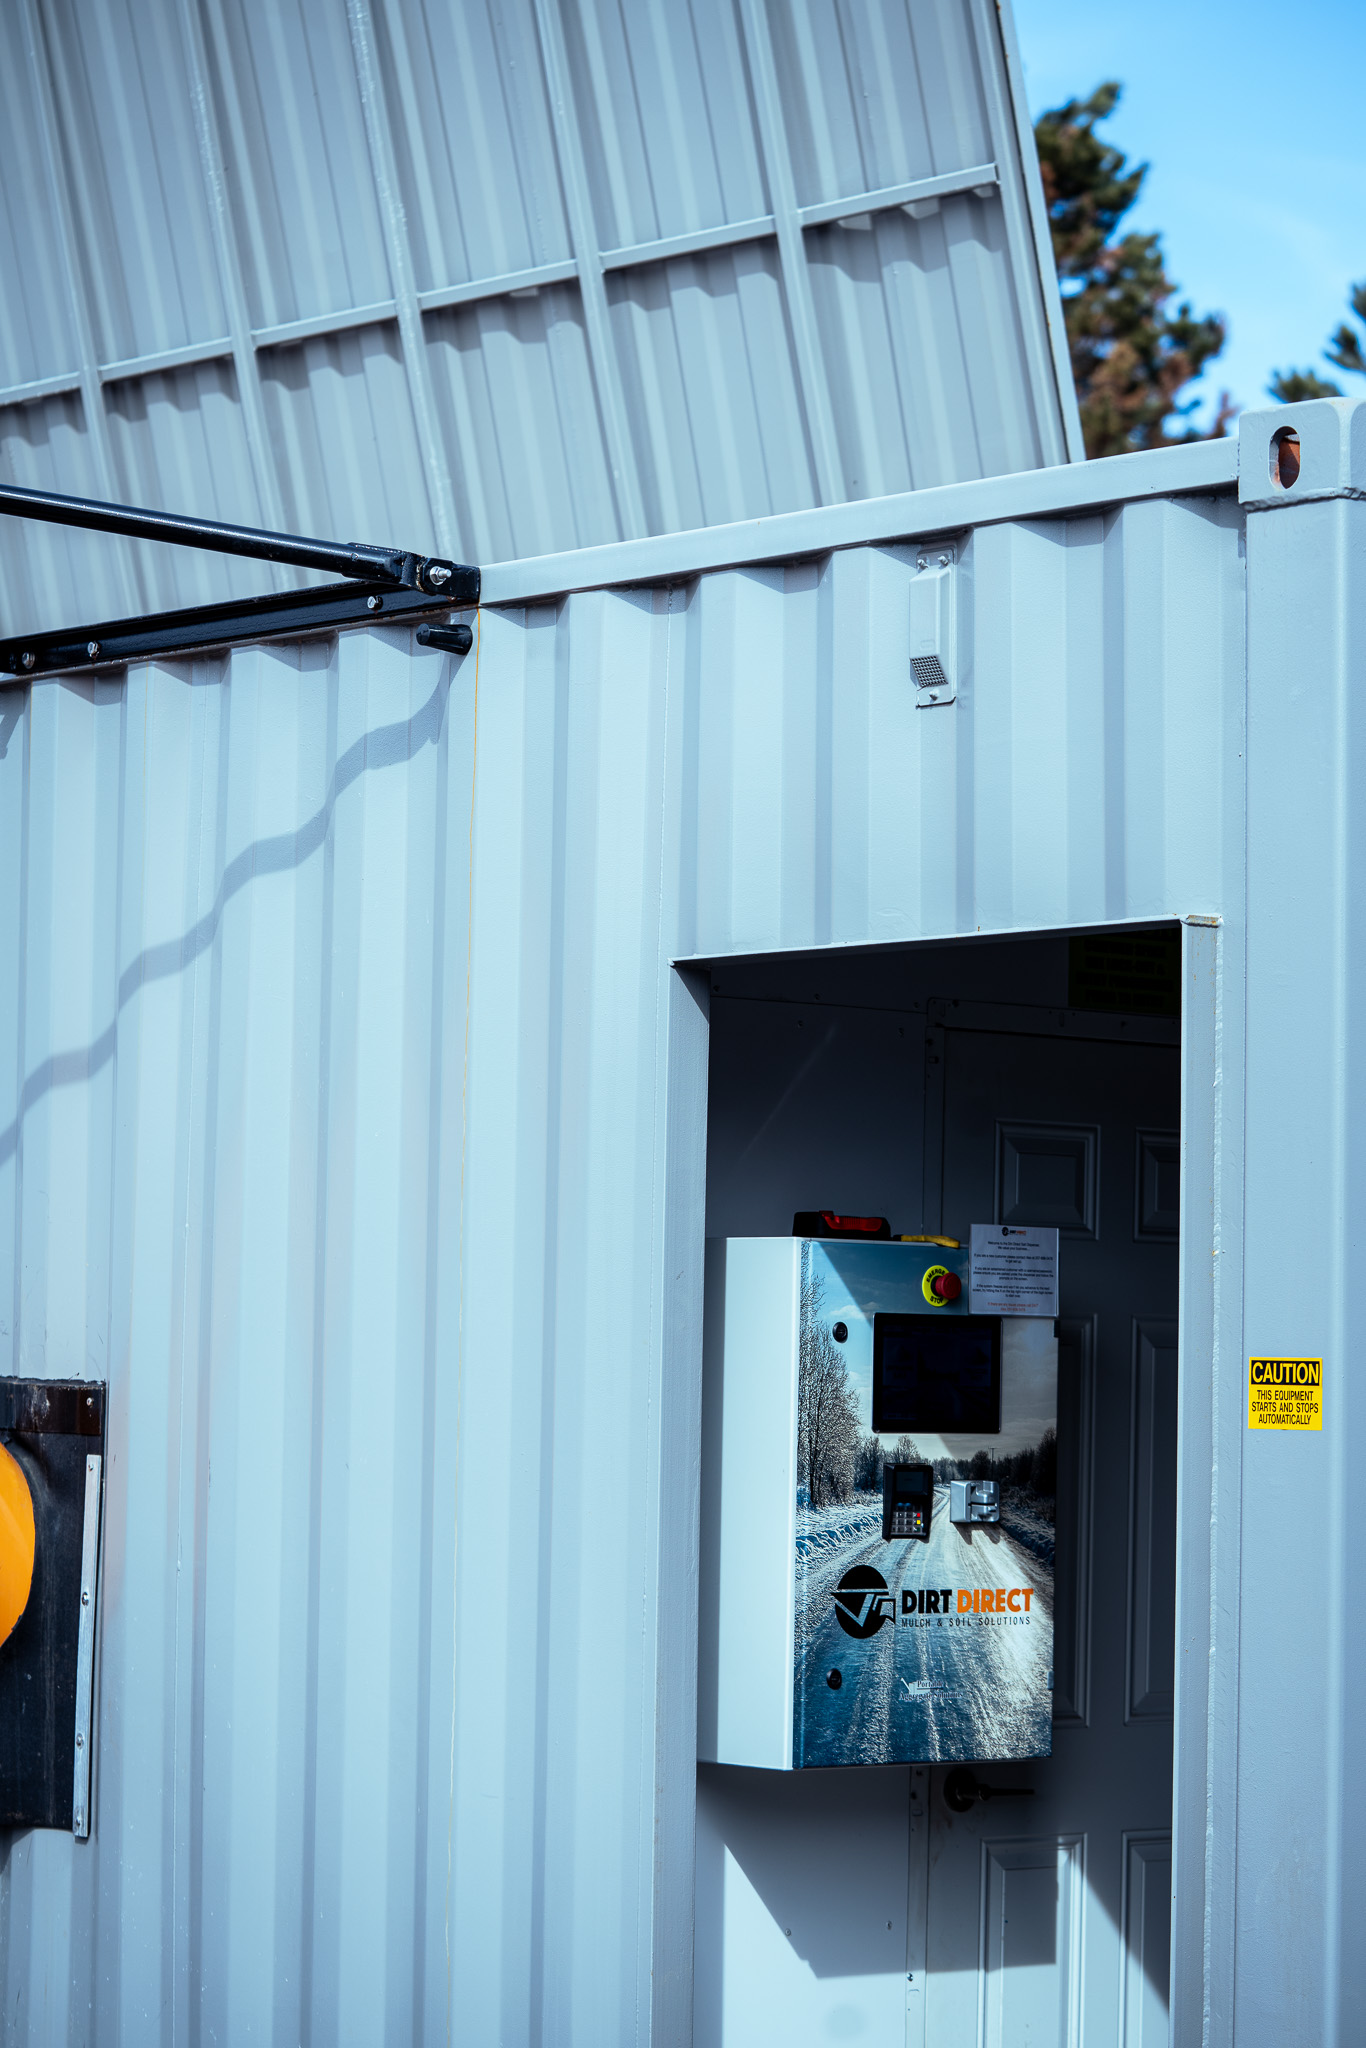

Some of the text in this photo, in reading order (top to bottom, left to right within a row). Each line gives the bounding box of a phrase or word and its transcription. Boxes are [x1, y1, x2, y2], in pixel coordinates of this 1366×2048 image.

[1252, 1361, 1319, 1384] CAUTION
[1257, 1389, 1314, 1401] THIS EQUIPMENT
[1251, 1401, 1319, 1414] STARTS AND STOPS
[1258, 1413, 1312, 1425] AUTOMATICALLY
[901, 1588, 1034, 1614] DIRT DIRECT
[901, 1616, 1031, 1628] MULCH & SOIL SOLUTIONS
